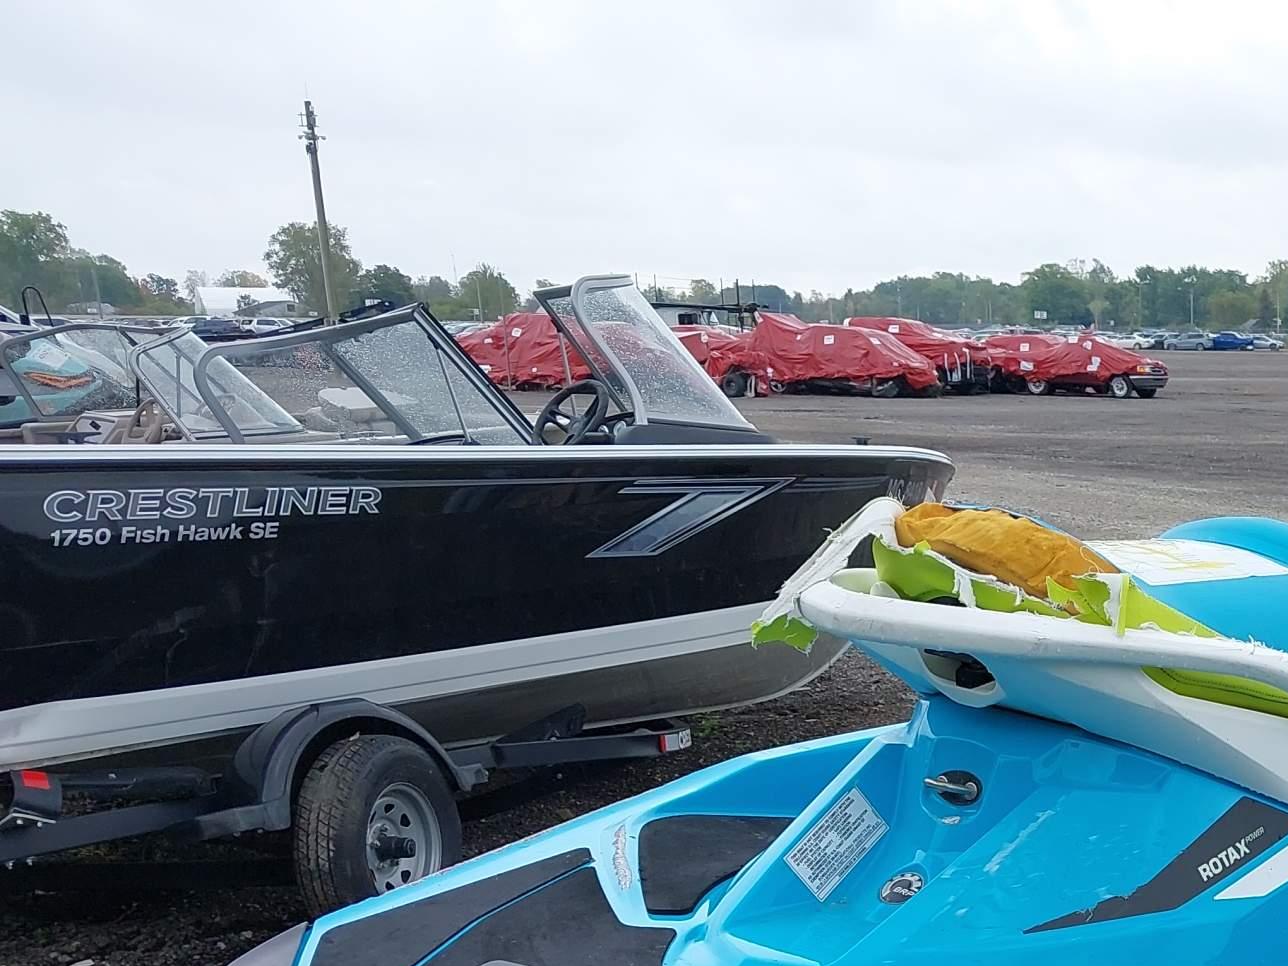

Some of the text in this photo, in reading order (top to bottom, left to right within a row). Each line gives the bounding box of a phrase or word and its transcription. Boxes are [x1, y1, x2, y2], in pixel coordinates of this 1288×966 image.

[43, 486, 382, 522] CRESTLINER
[50, 522, 280, 547] 1750 Fish Hawk SE
[1197, 838, 1250, 882] ROTAX
